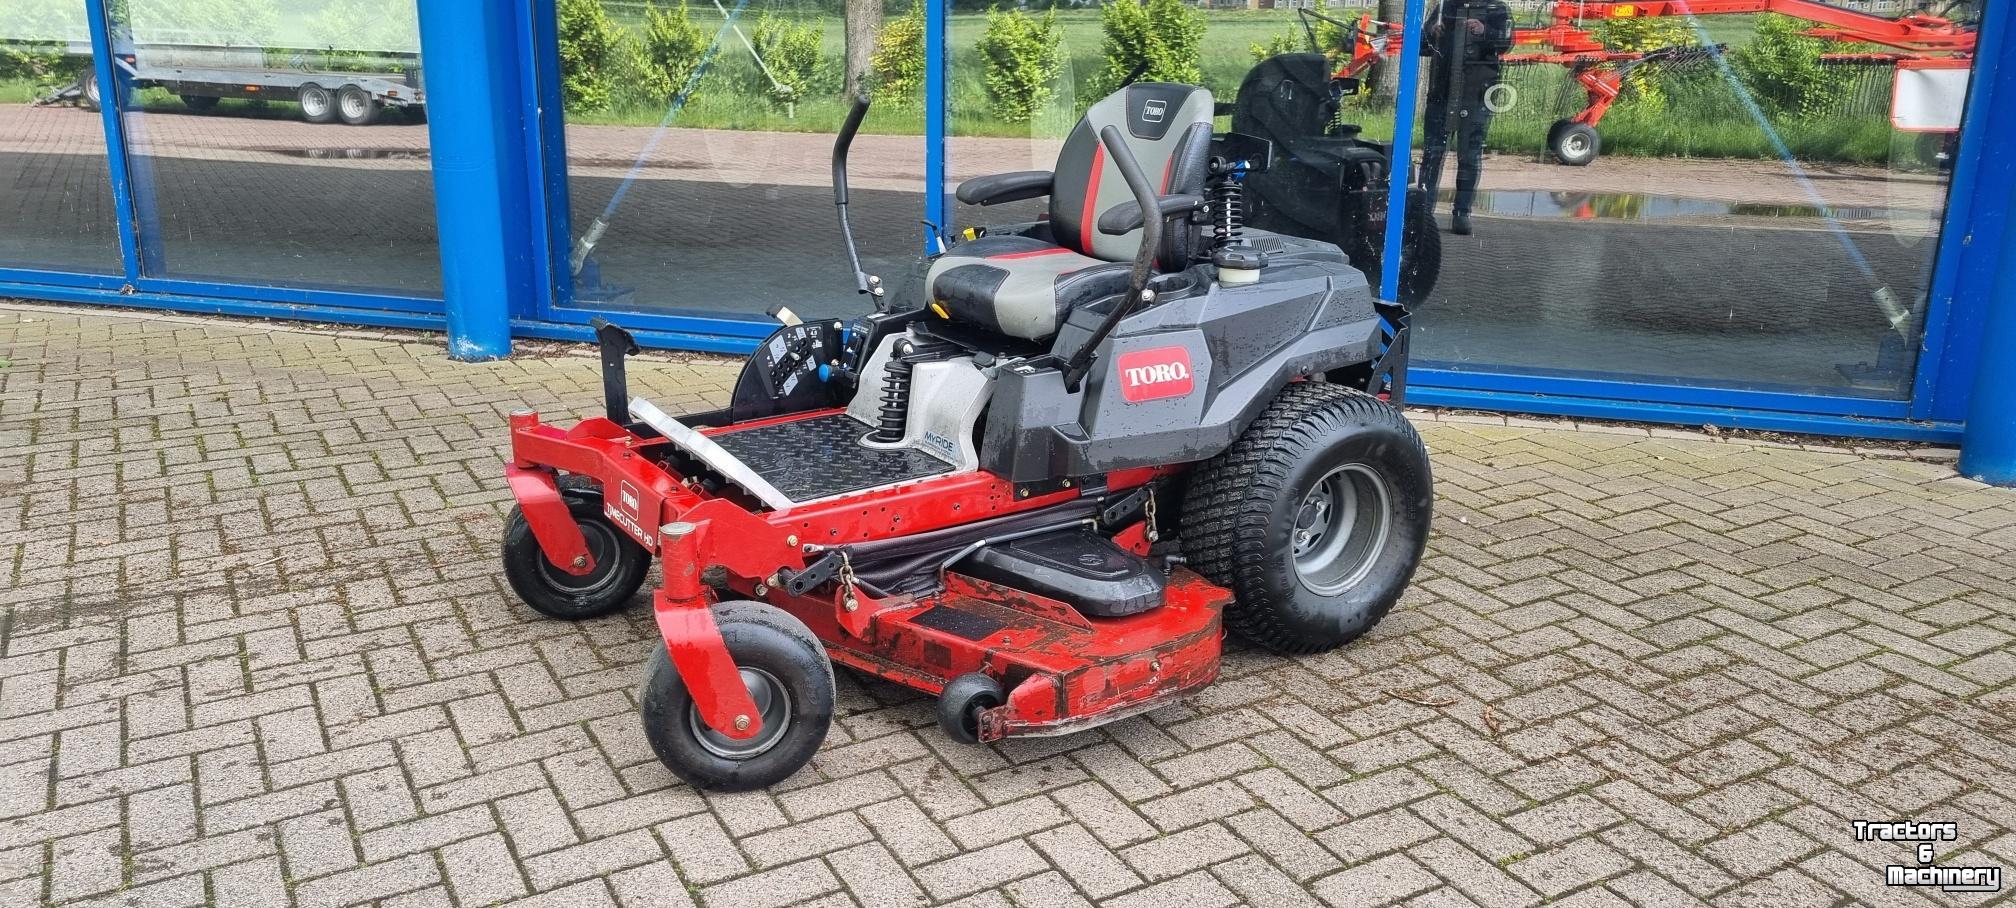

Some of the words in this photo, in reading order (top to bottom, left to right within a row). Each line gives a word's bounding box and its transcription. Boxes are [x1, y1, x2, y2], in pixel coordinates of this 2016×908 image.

[1145, 106, 1164, 116] TORO
[623, 490, 637, 510] TORO
[606, 502, 643, 540] TIMECUTTER
[643, 532, 654, 547] HD
